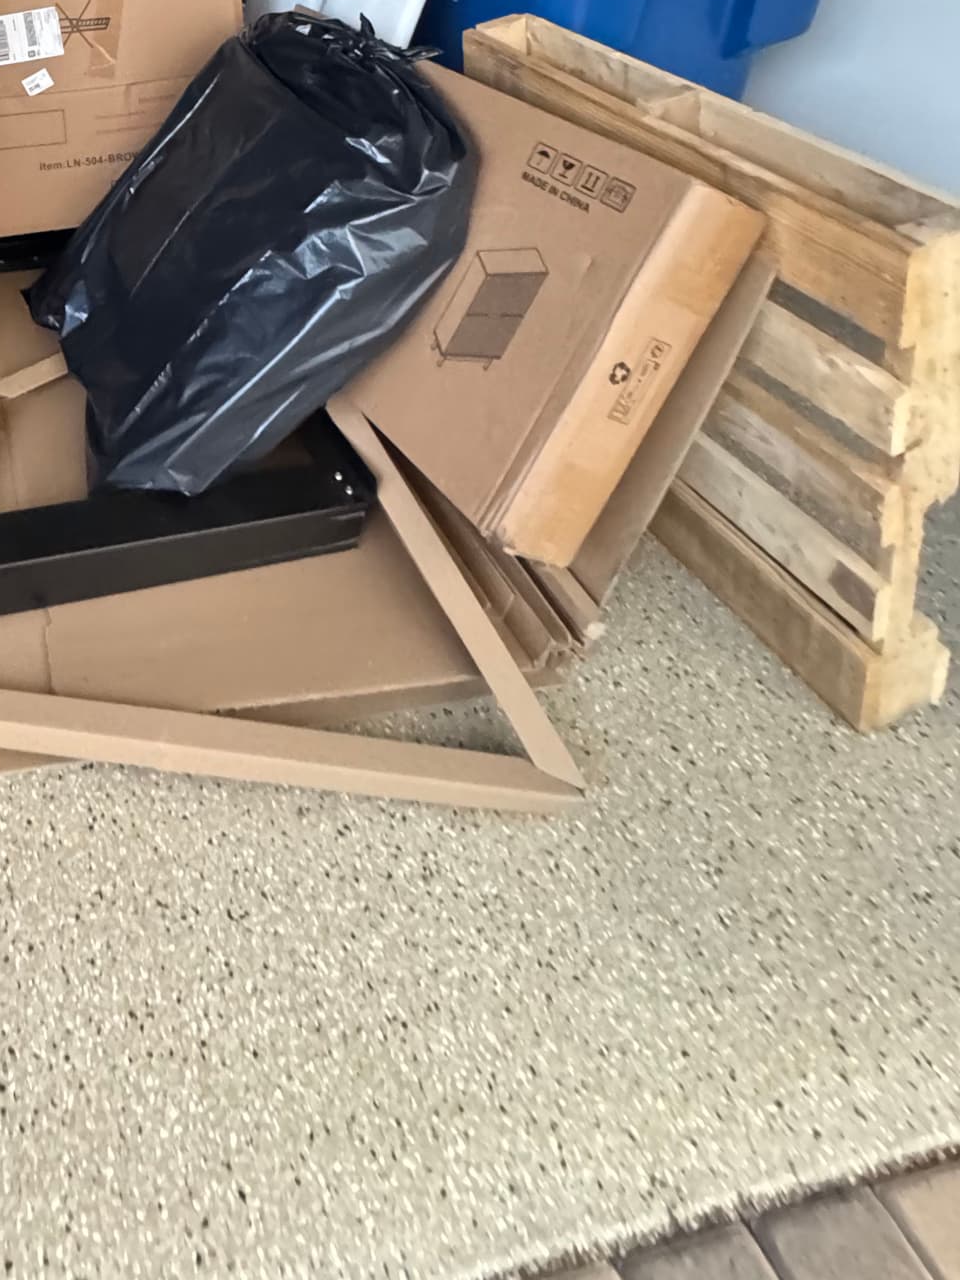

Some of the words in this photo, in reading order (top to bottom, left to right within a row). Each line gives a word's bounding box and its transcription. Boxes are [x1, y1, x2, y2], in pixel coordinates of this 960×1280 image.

[521, 171, 549, 191] MADE
[548, 184, 559, 197] IN
[559, 191, 590, 214] CHINA
